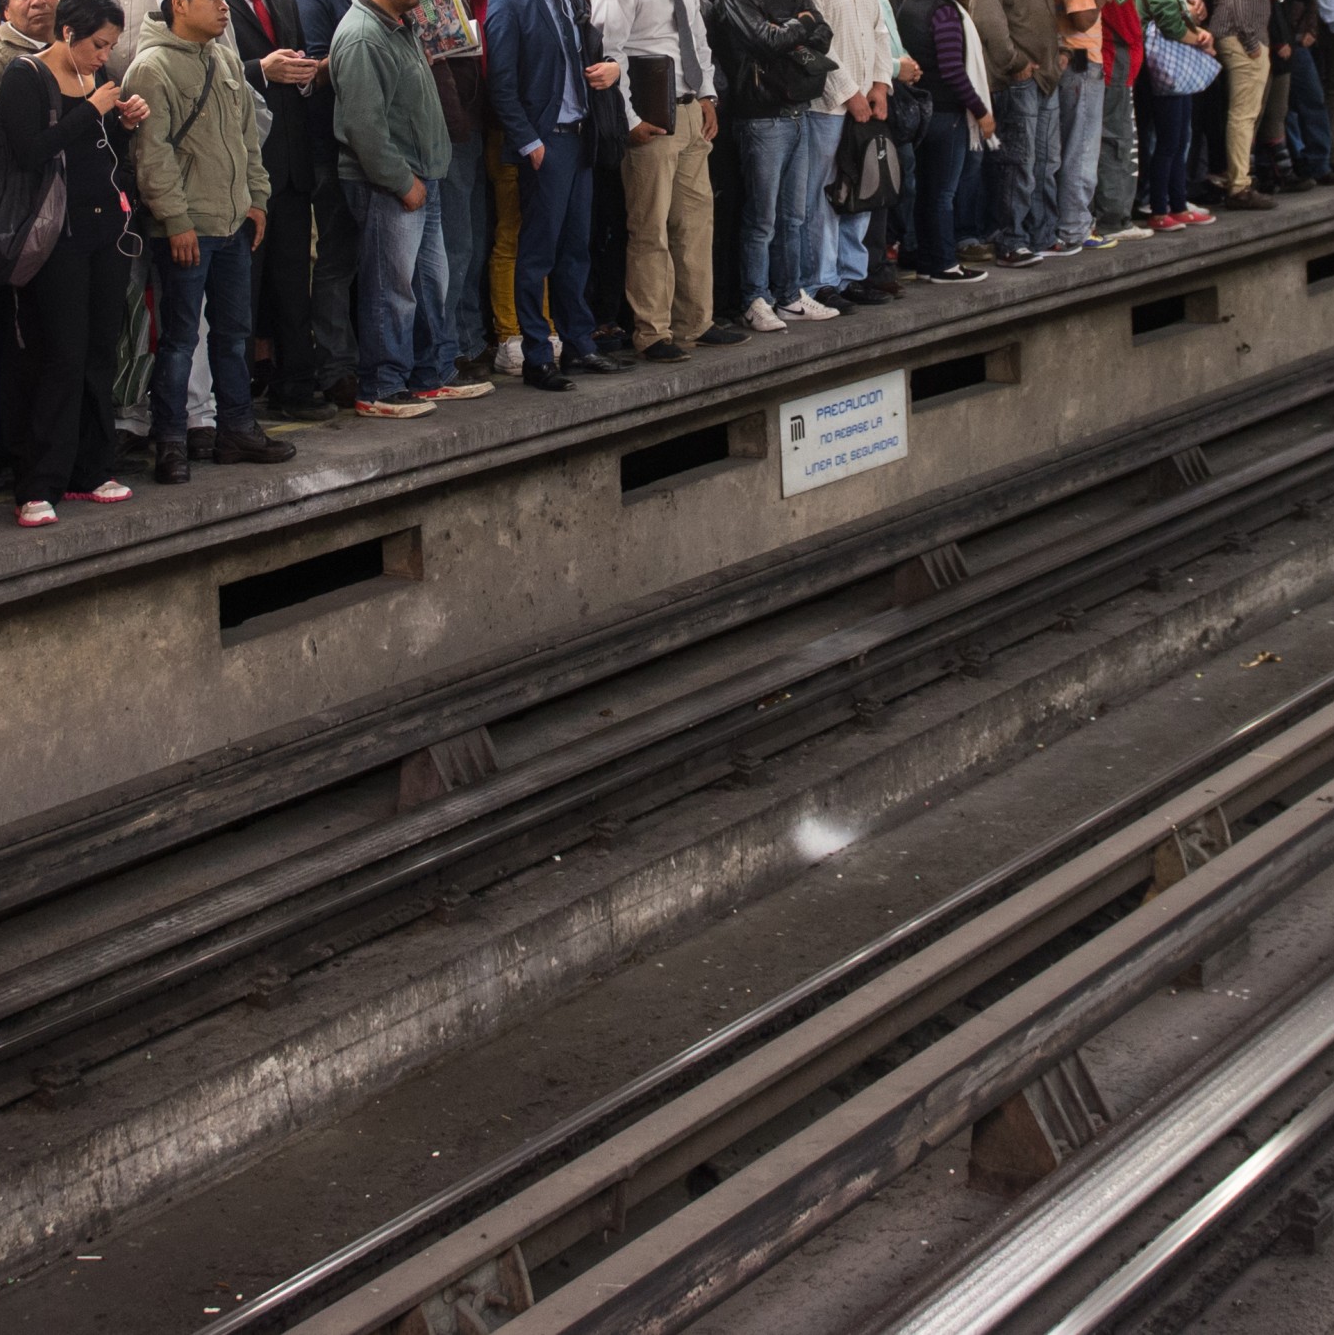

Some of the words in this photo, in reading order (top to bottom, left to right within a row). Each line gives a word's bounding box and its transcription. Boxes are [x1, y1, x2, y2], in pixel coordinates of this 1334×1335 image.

[816, 389, 884, 421] PRECAUCION
[820, 432, 833, 445] NO
[834, 420, 869, 441] REBASE
[870, 416, 883, 429] LA
[805, 458, 832, 476] LINEA
[835, 453, 847, 466] DE
[850, 435, 899, 462] SEGURIDAD
